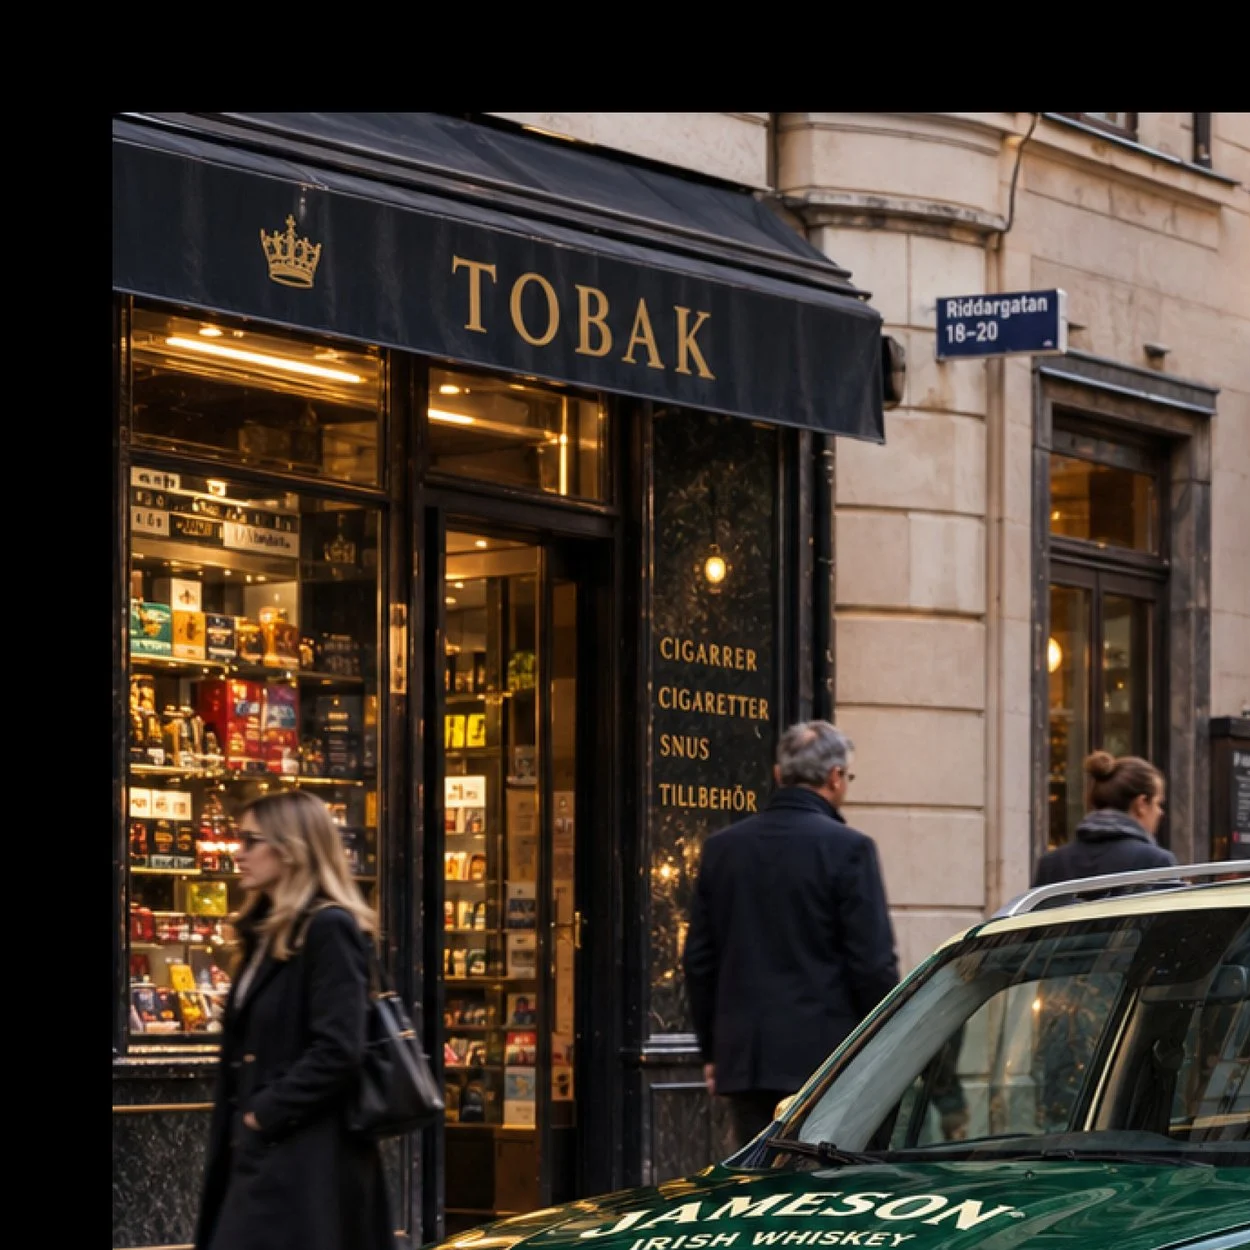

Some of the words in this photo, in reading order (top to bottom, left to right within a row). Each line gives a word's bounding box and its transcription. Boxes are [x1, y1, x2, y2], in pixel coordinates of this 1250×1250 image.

[452, 255, 716, 380] TOBAK
[946, 295, 1048, 319] Riddargatan
[660, 636, 758, 672] CIGARRER
[658, 685, 769, 721] CIGARETTER
[660, 733, 710, 761] SNUS
[659, 783, 758, 813] TILLBEHÖR
[579, 1192, 1017, 1239] JAMESON
[751, 1230, 916, 1249] WHISKEY
